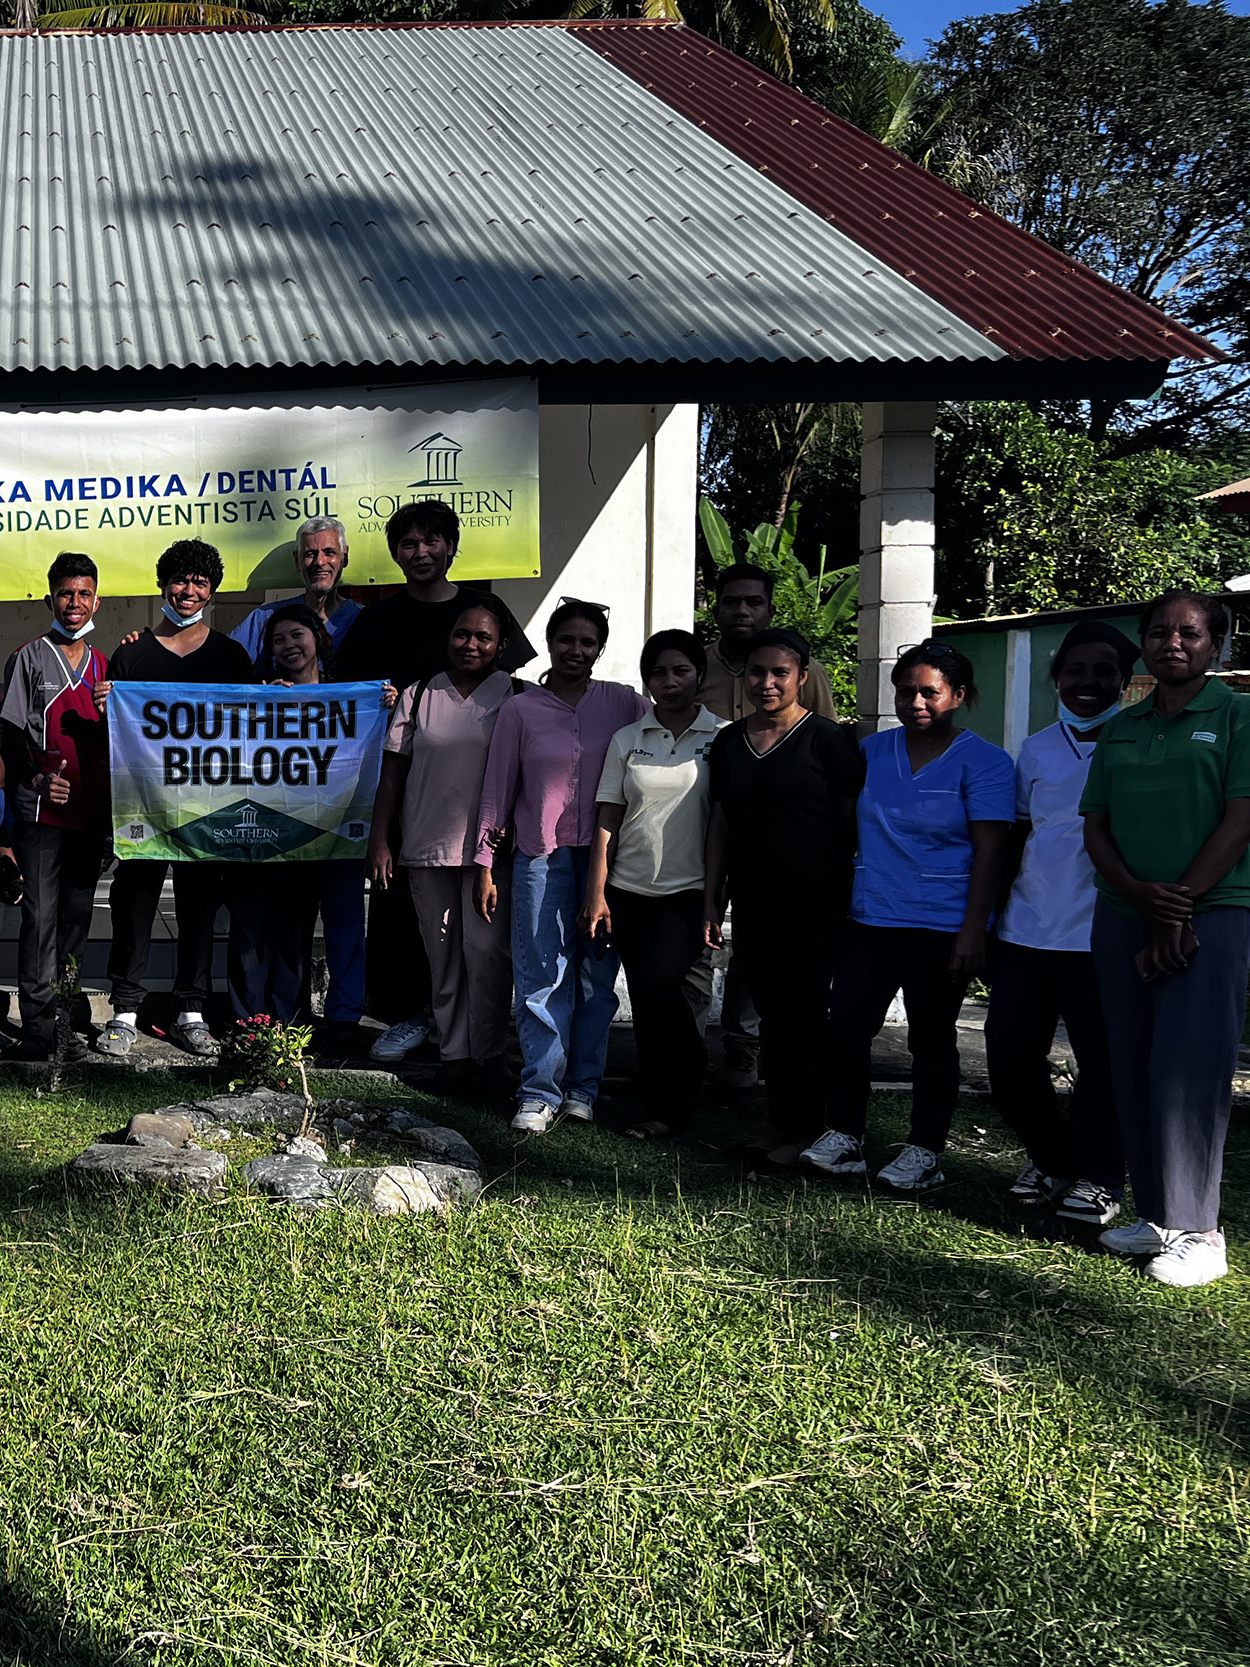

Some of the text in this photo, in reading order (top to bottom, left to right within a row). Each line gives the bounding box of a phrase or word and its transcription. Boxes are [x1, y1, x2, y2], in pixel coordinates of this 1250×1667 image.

[44, 473, 188, 502] MEDIKA
[97, 500, 277, 529] ADVENTISTA
[284, 492, 339, 520] SÚL
[458, 514, 512, 528] VERSITY
[141, 699, 357, 740] SOUTHERN
[163, 744, 339, 786] BIOLOGY
[213, 828, 280, 839] SOUTHERN
